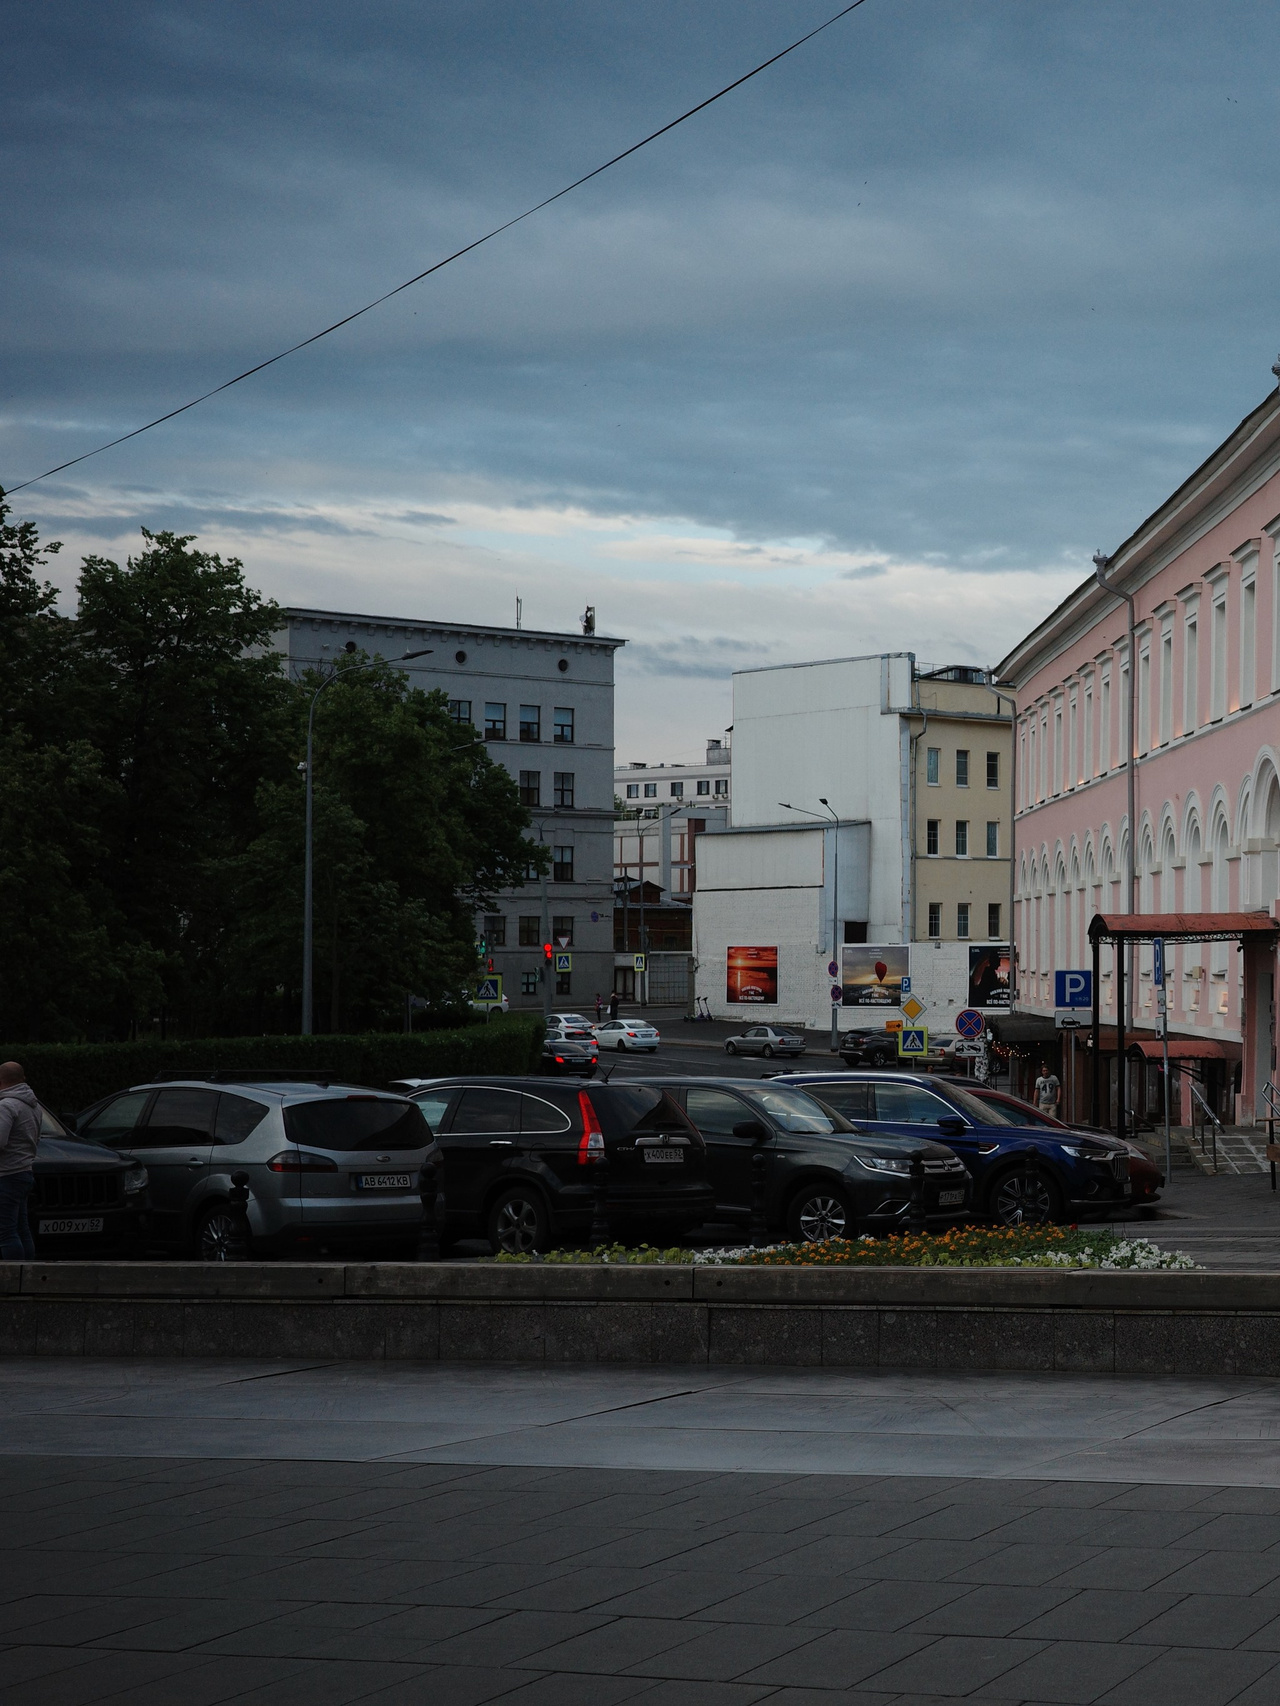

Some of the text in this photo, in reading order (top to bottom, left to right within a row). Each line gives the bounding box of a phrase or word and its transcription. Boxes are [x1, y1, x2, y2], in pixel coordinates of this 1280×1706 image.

[1065, 973, 1085, 1003] P
[377, 1176, 396, 1186] 6412
[90, 1219, 101, 1228] 52
